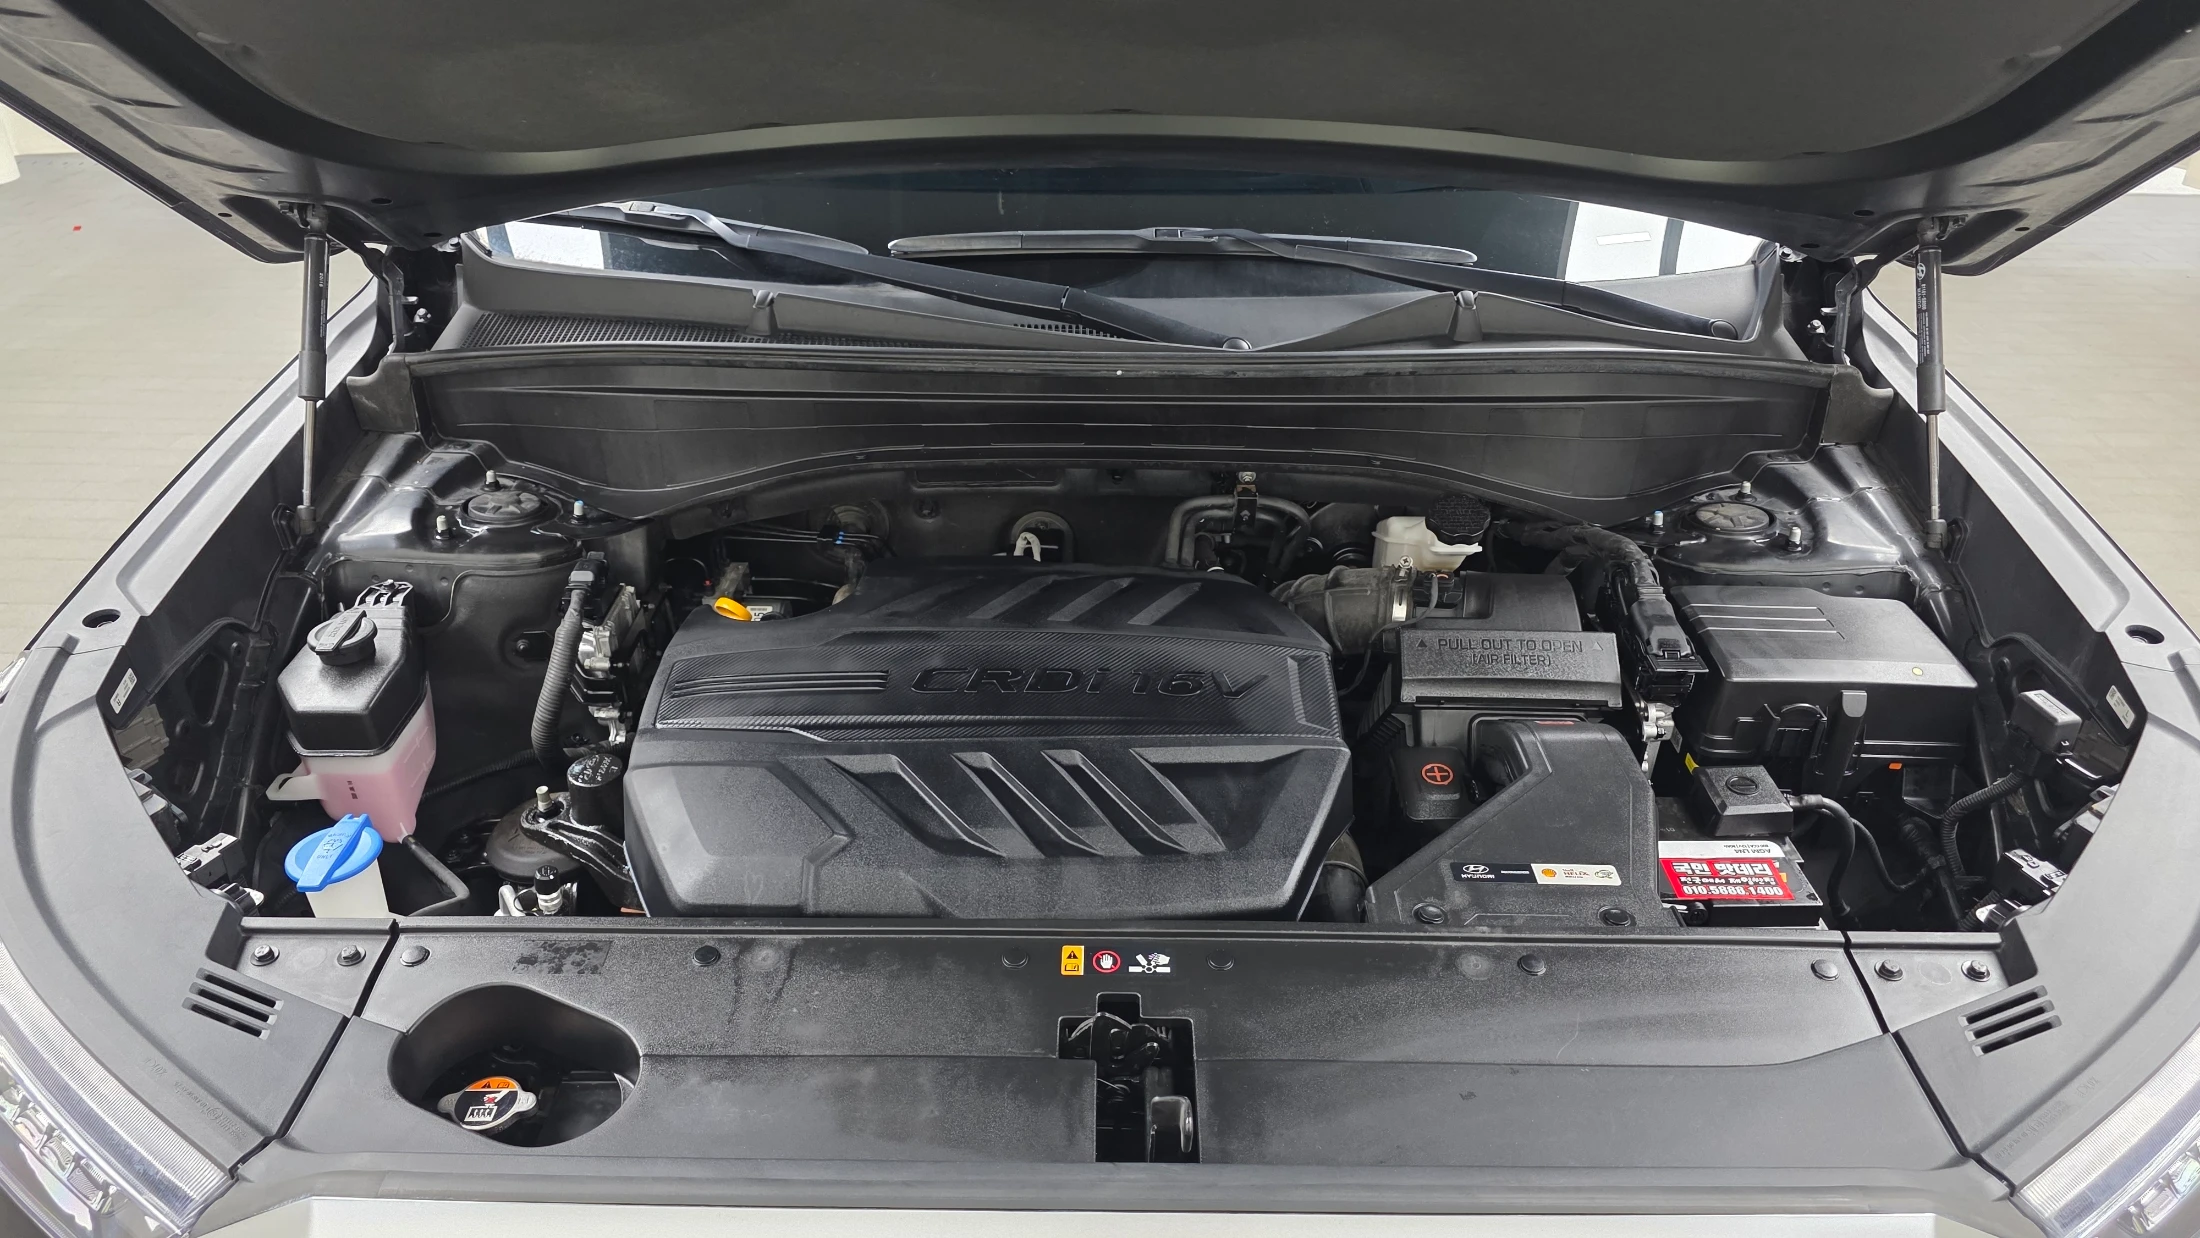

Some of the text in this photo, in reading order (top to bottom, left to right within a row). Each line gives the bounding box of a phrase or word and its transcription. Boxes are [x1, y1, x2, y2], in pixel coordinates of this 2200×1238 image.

[1437, 638, 1583, 653] PULL OUT TO OPEN
[910, 668, 1268, 699] CRDi 16V
[1671, 862, 1712, 875] 국민
